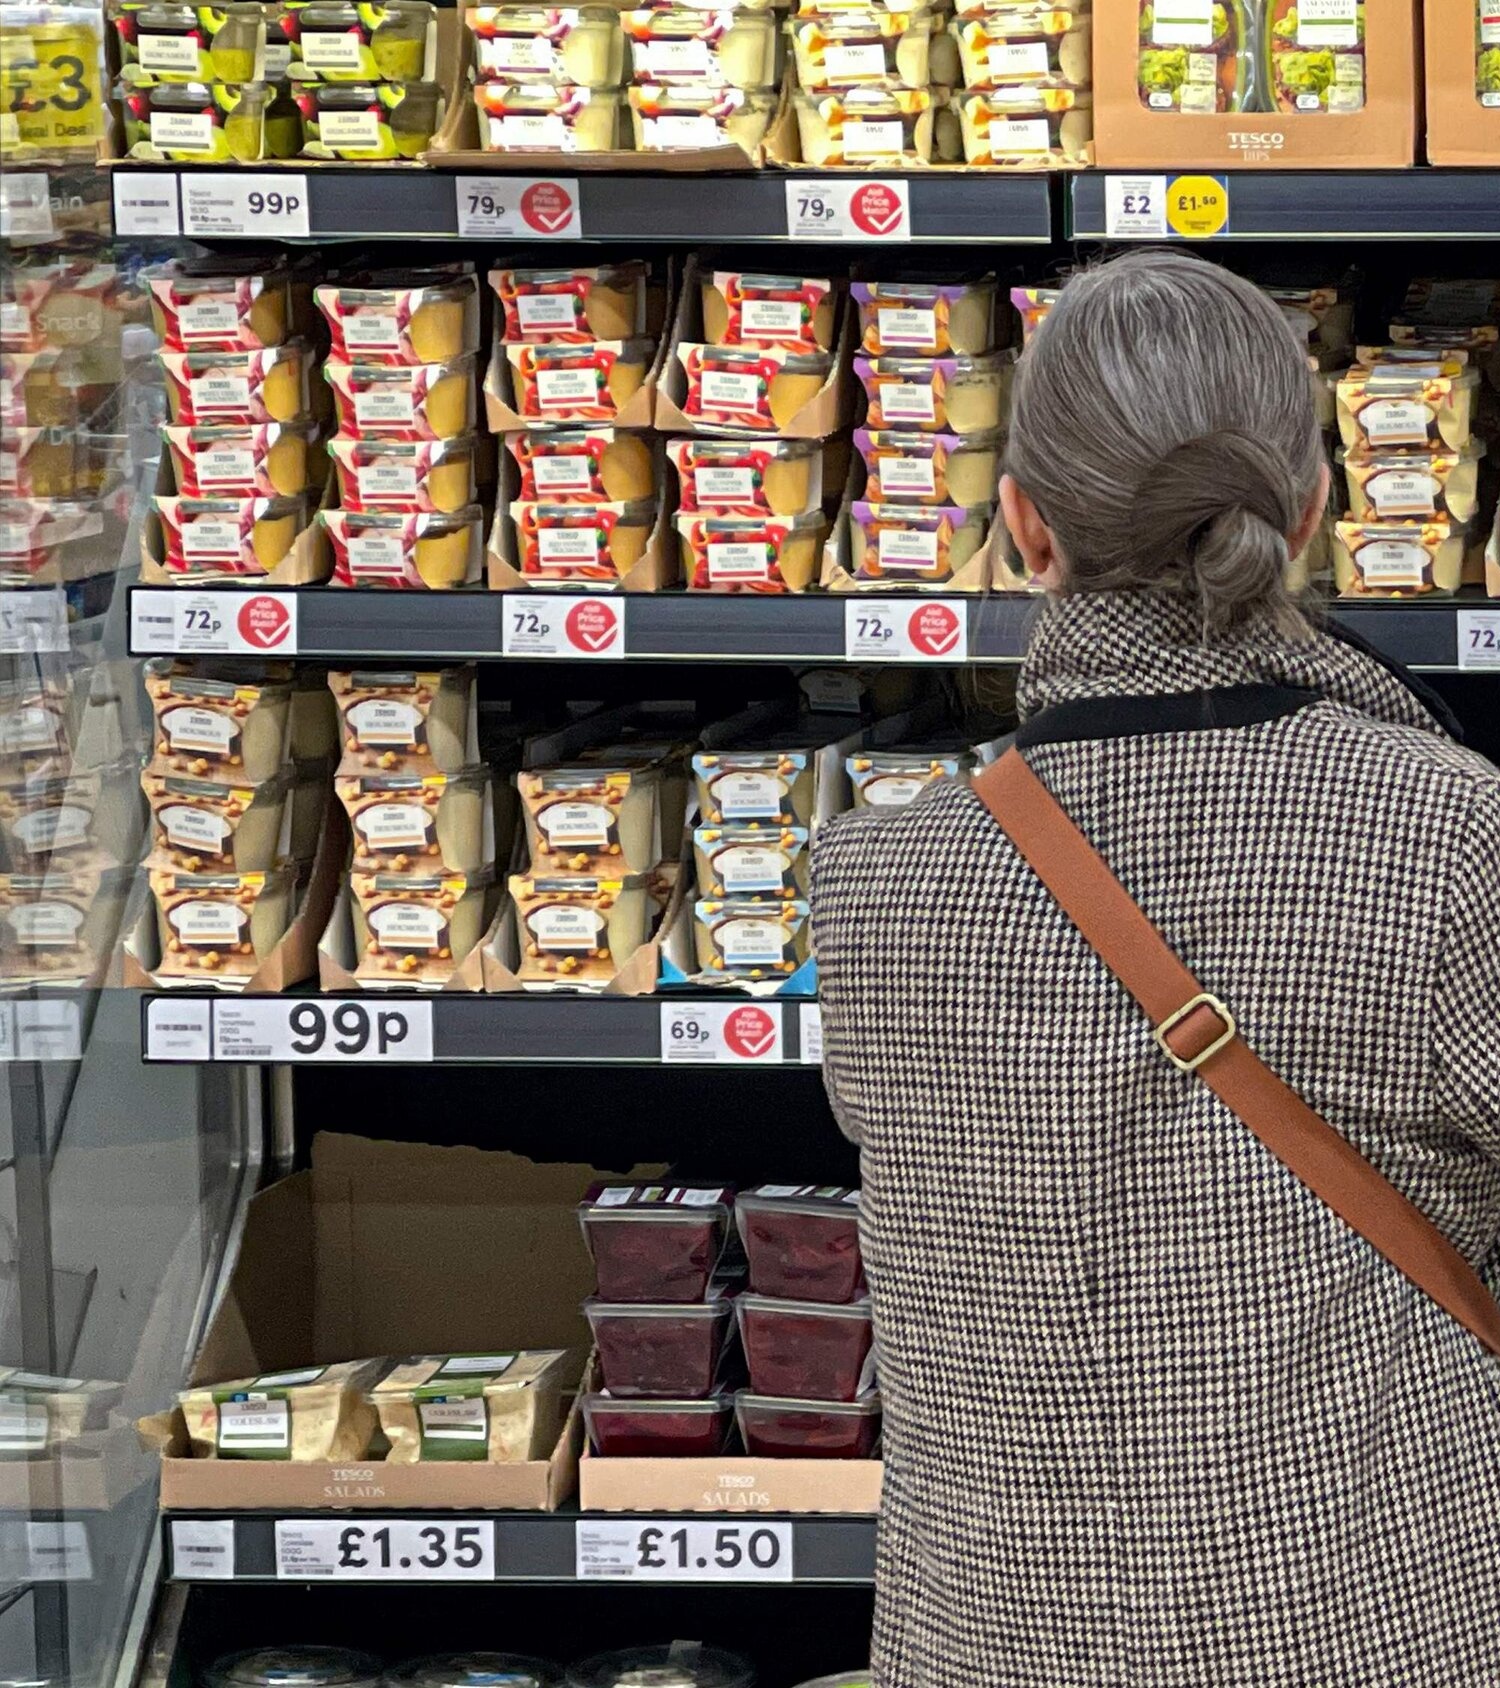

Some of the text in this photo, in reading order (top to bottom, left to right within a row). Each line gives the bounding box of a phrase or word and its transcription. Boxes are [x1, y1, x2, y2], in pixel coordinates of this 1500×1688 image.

[1228, 132, 1284, 145] TESCO
[248, 192, 300, 215] 99p
[467, 195, 505, 218] 79p
[797, 198, 835, 219] 79p
[861, 196, 892, 207] Price
[1123, 195, 1151, 214] £2
[1178, 196, 1217, 210] £1.50
[184, 610, 221, 633] 72p
[249, 609, 278, 620] Price
[920, 617, 948, 627] Price
[513, 614, 550, 637] 72p
[856, 619, 893, 641] 72p
[289, 1002, 408, 1054] 99p
[671, 1021, 709, 1044] 69p
[332, 1469, 374, 1478] TESCO
[324, 1486, 386, 1498] SALADS
[702, 1492, 771, 1507] SALADS
[338, 1526, 482, 1569] £1.35
[638, 1528, 781, 1568] £1.50
